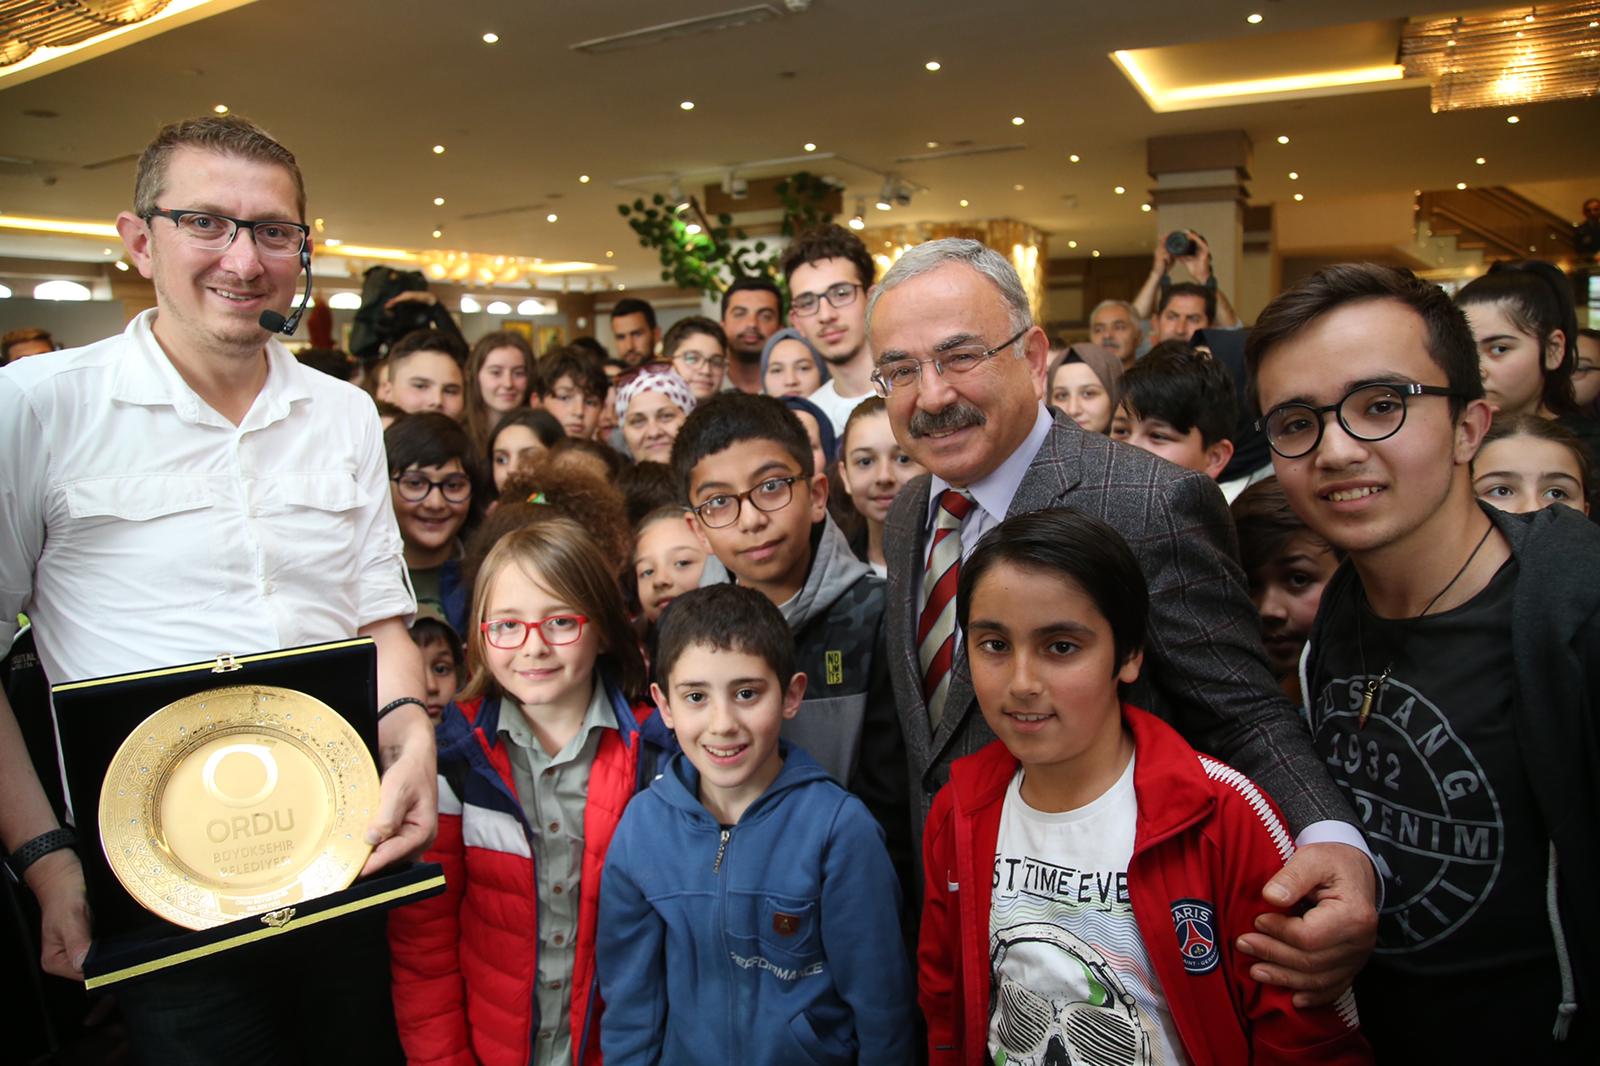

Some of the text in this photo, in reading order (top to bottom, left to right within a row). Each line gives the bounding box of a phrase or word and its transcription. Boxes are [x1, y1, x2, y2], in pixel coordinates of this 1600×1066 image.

[1317, 681, 1479, 800] USTANG
[1326, 732, 1402, 791] 1932
[206, 808, 295, 843] ORDU
[1354, 796, 1489, 858] DENIM
[992, 857, 1130, 904] ST TIME EVE
[1172, 907, 1210, 923] ARIS
